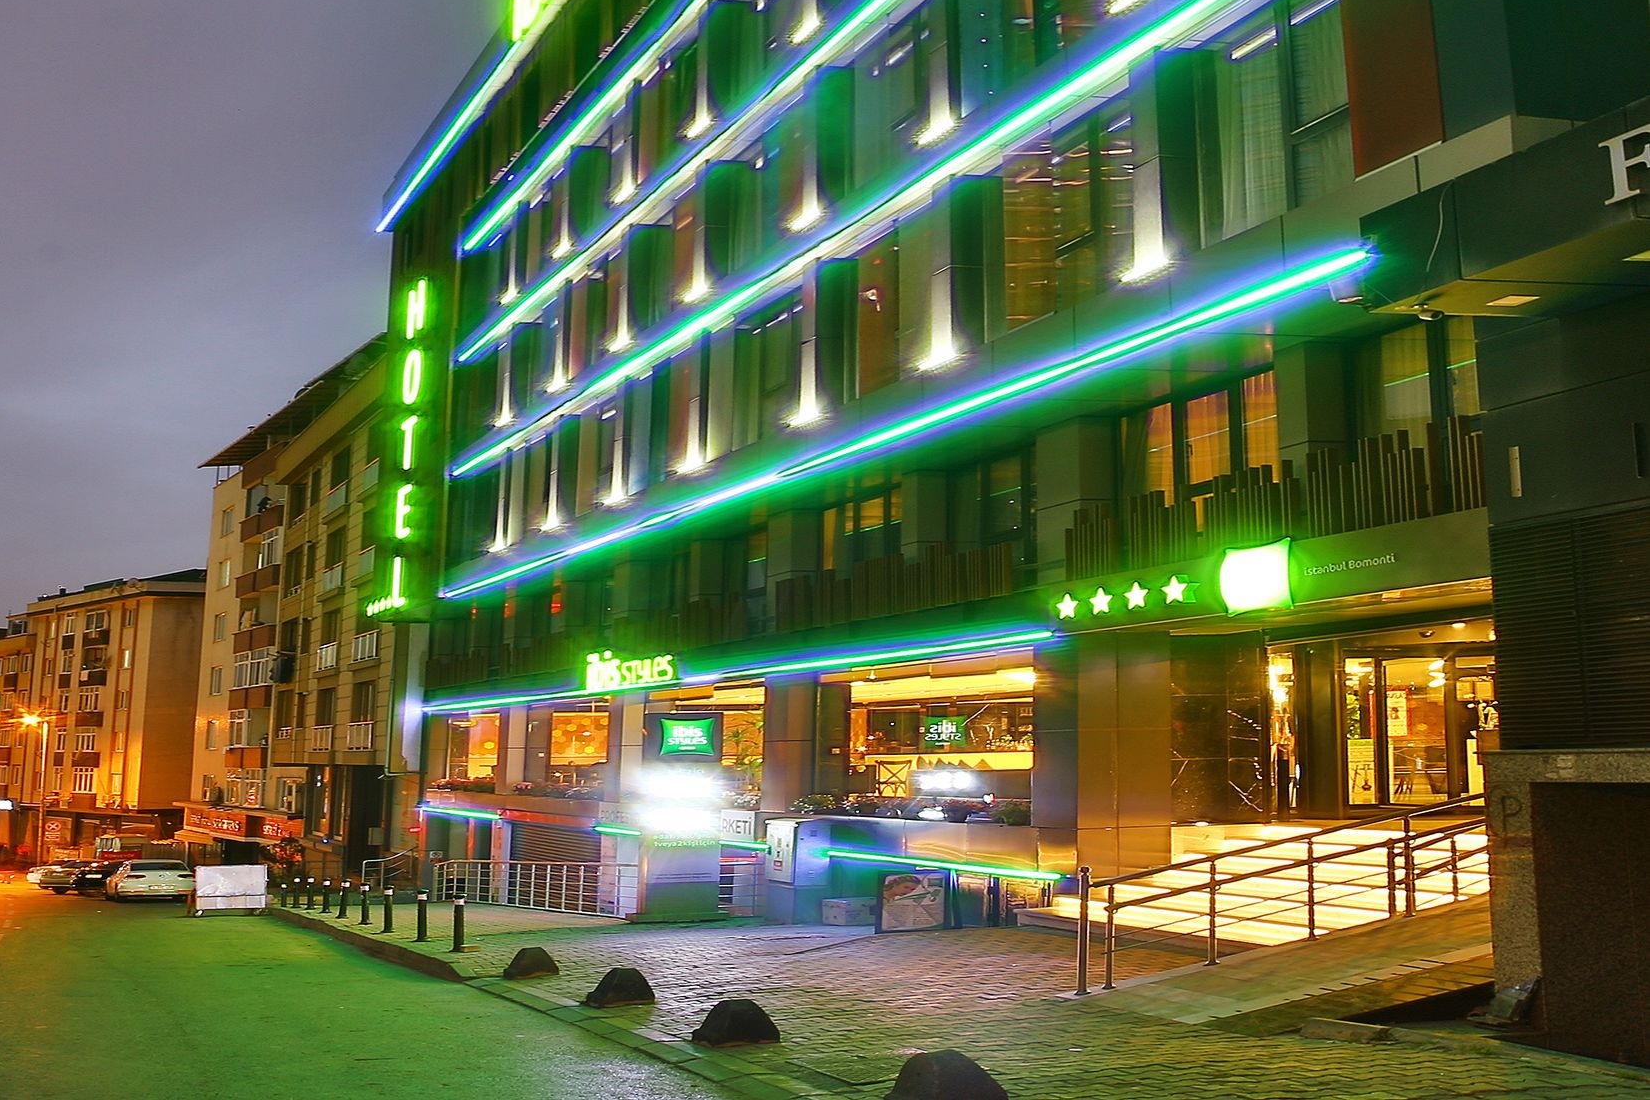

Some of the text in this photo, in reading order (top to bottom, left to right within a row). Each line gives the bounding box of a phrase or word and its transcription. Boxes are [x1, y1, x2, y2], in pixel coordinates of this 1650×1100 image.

[392, 278, 427, 608] HOTEL
[1348, 553, 1396, 569] Bomonti
[672, 725, 704, 738] ibis
